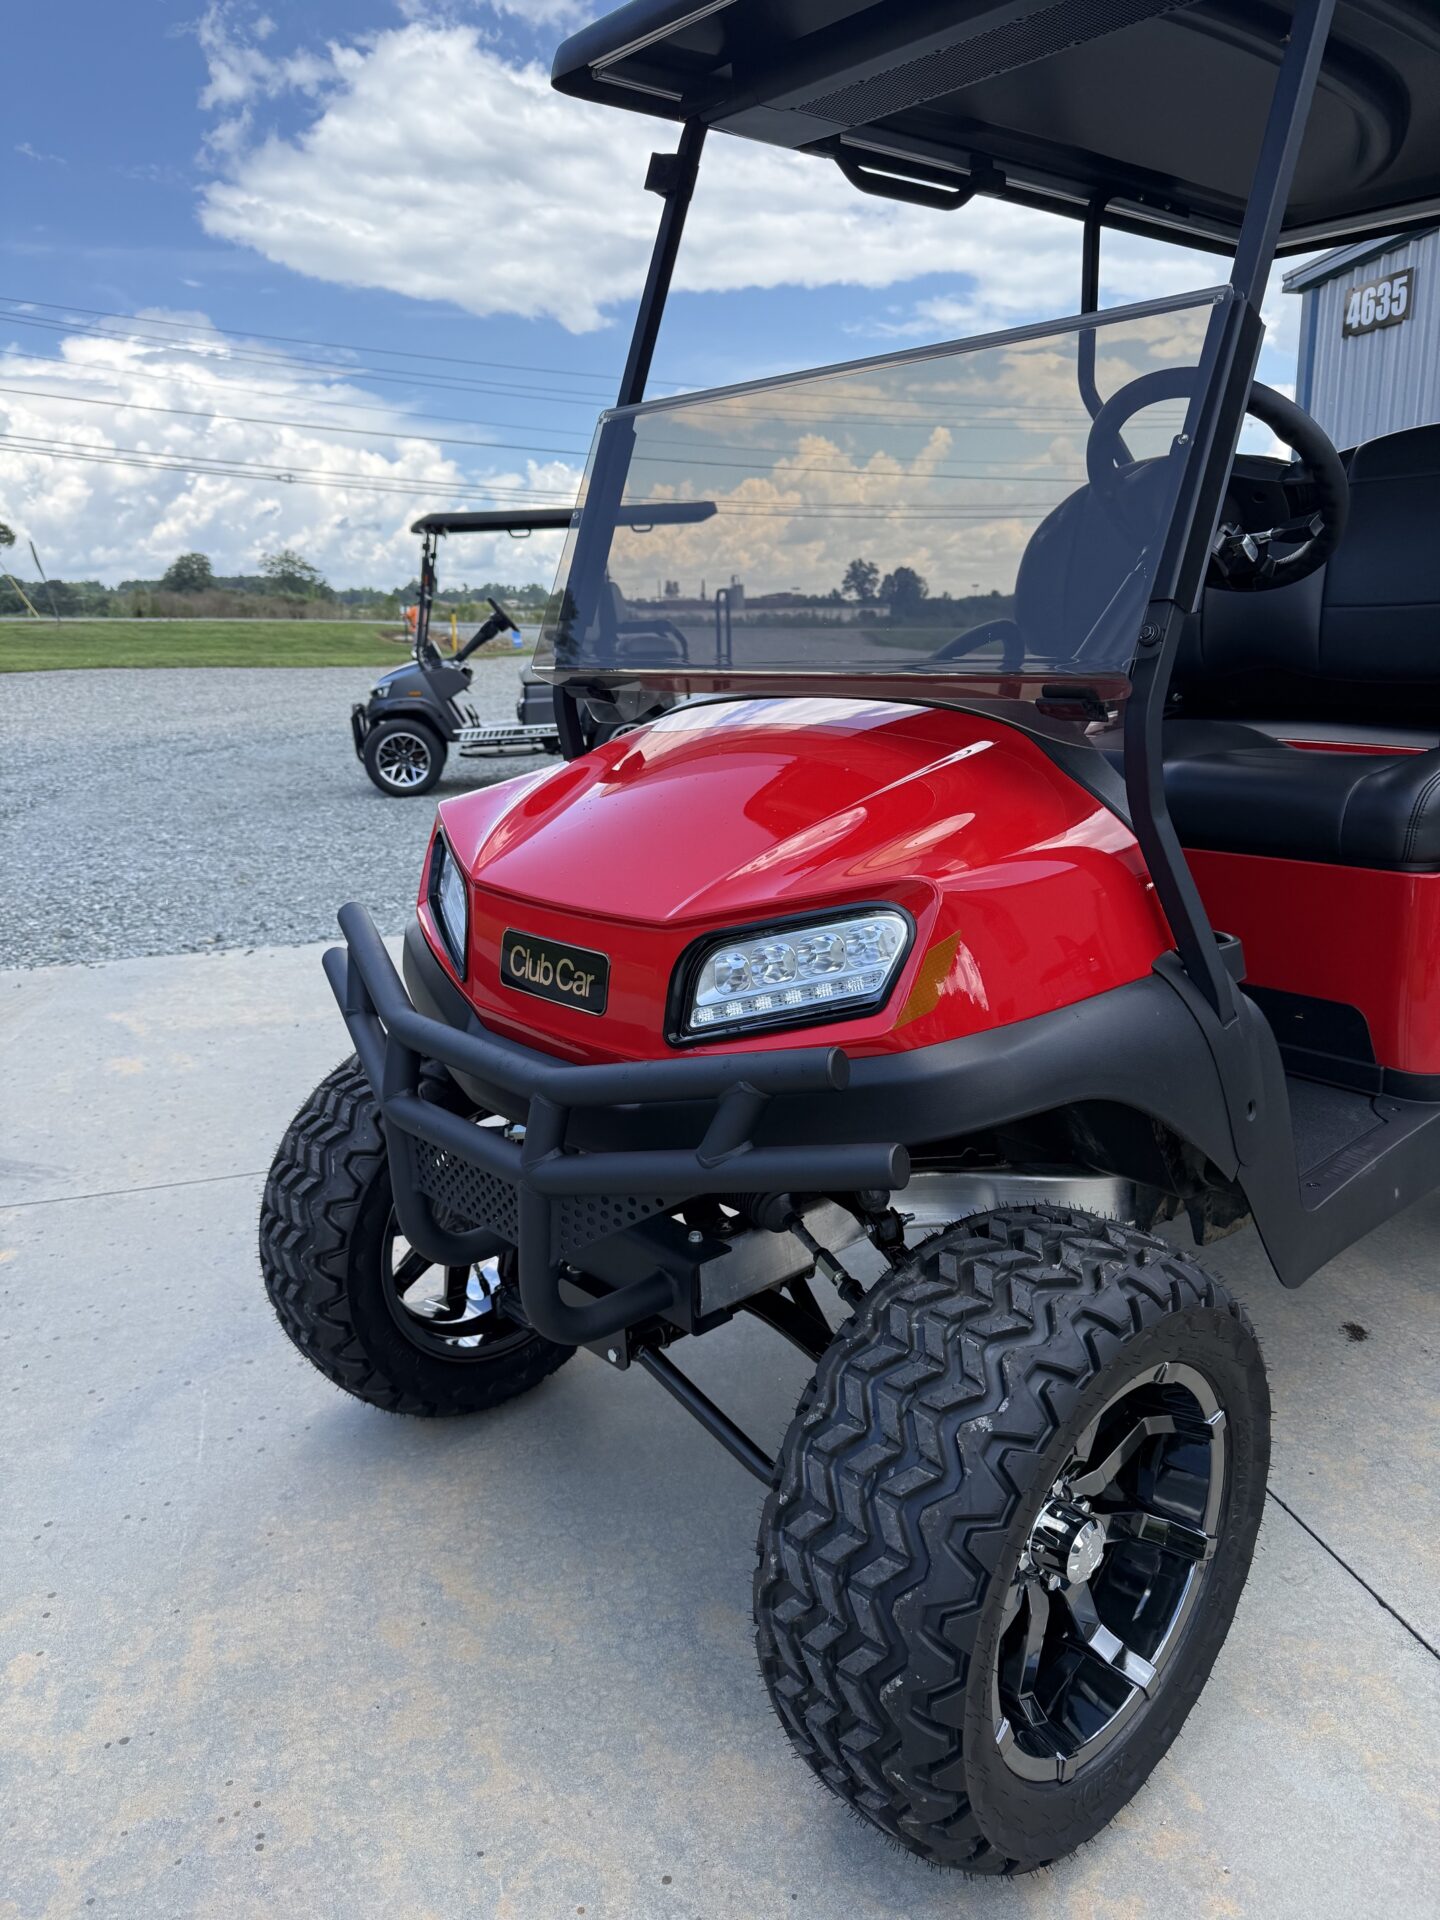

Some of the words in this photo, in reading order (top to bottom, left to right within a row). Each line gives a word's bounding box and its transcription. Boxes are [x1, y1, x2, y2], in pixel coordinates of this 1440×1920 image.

[1346, 275, 1408, 328] 4635
[510, 945, 553, 985] Club
[556, 959, 594, 997] Car
